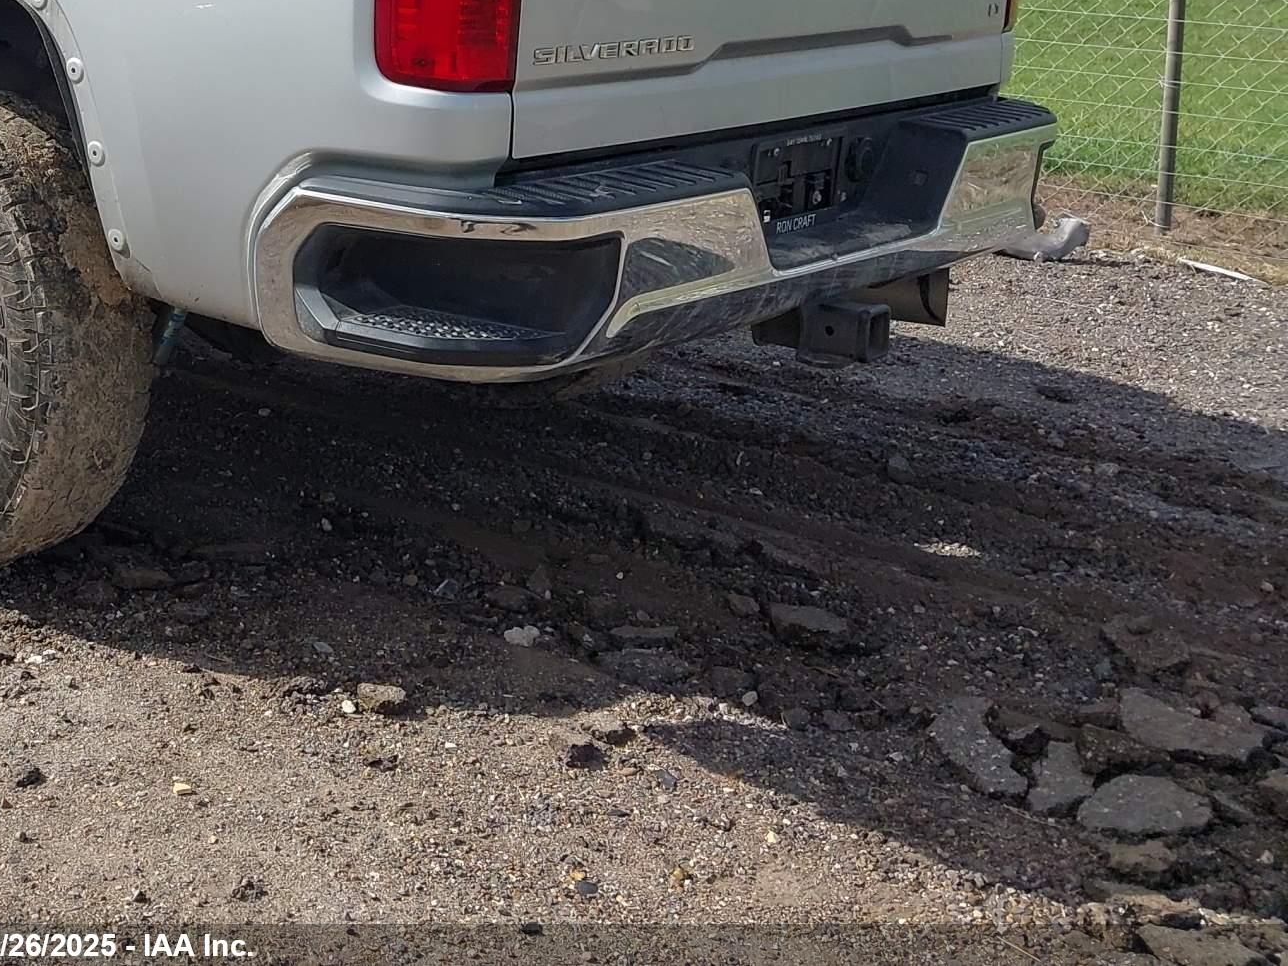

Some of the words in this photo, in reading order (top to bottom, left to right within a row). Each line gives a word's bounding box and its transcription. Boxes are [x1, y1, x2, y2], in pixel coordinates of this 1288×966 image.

[533, 35, 696, 65] SILVERADO
[776, 218, 793, 234] RON
[793, 214, 816, 230] CRAFT
